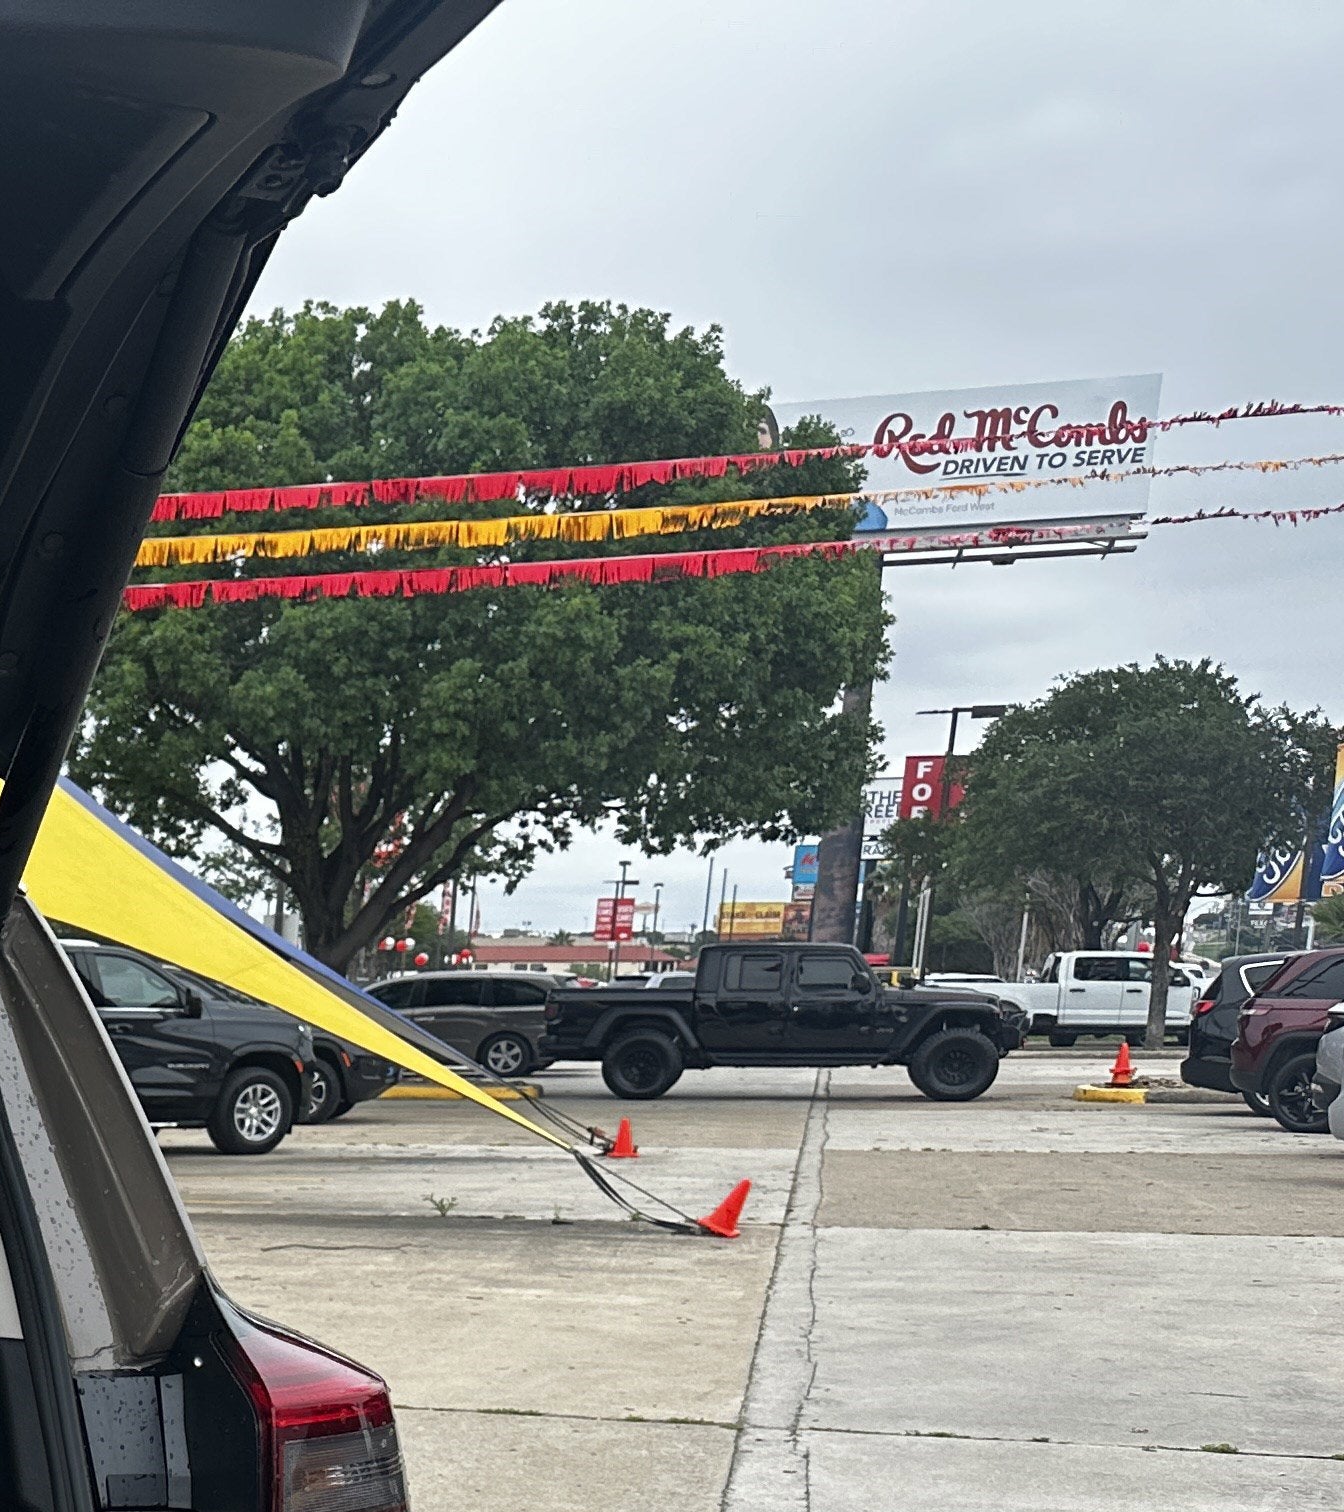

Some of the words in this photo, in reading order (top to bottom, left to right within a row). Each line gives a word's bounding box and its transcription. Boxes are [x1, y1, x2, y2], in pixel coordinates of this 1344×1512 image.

[873, 412, 956, 475] Red
[964, 400, 1148, 453] McCombs
[942, 453, 1029, 477] DRIVEN
[1036, 452, 1067, 470] TO
[1072, 447, 1146, 468] SERVE
[945, 503, 968, 513] Ford
